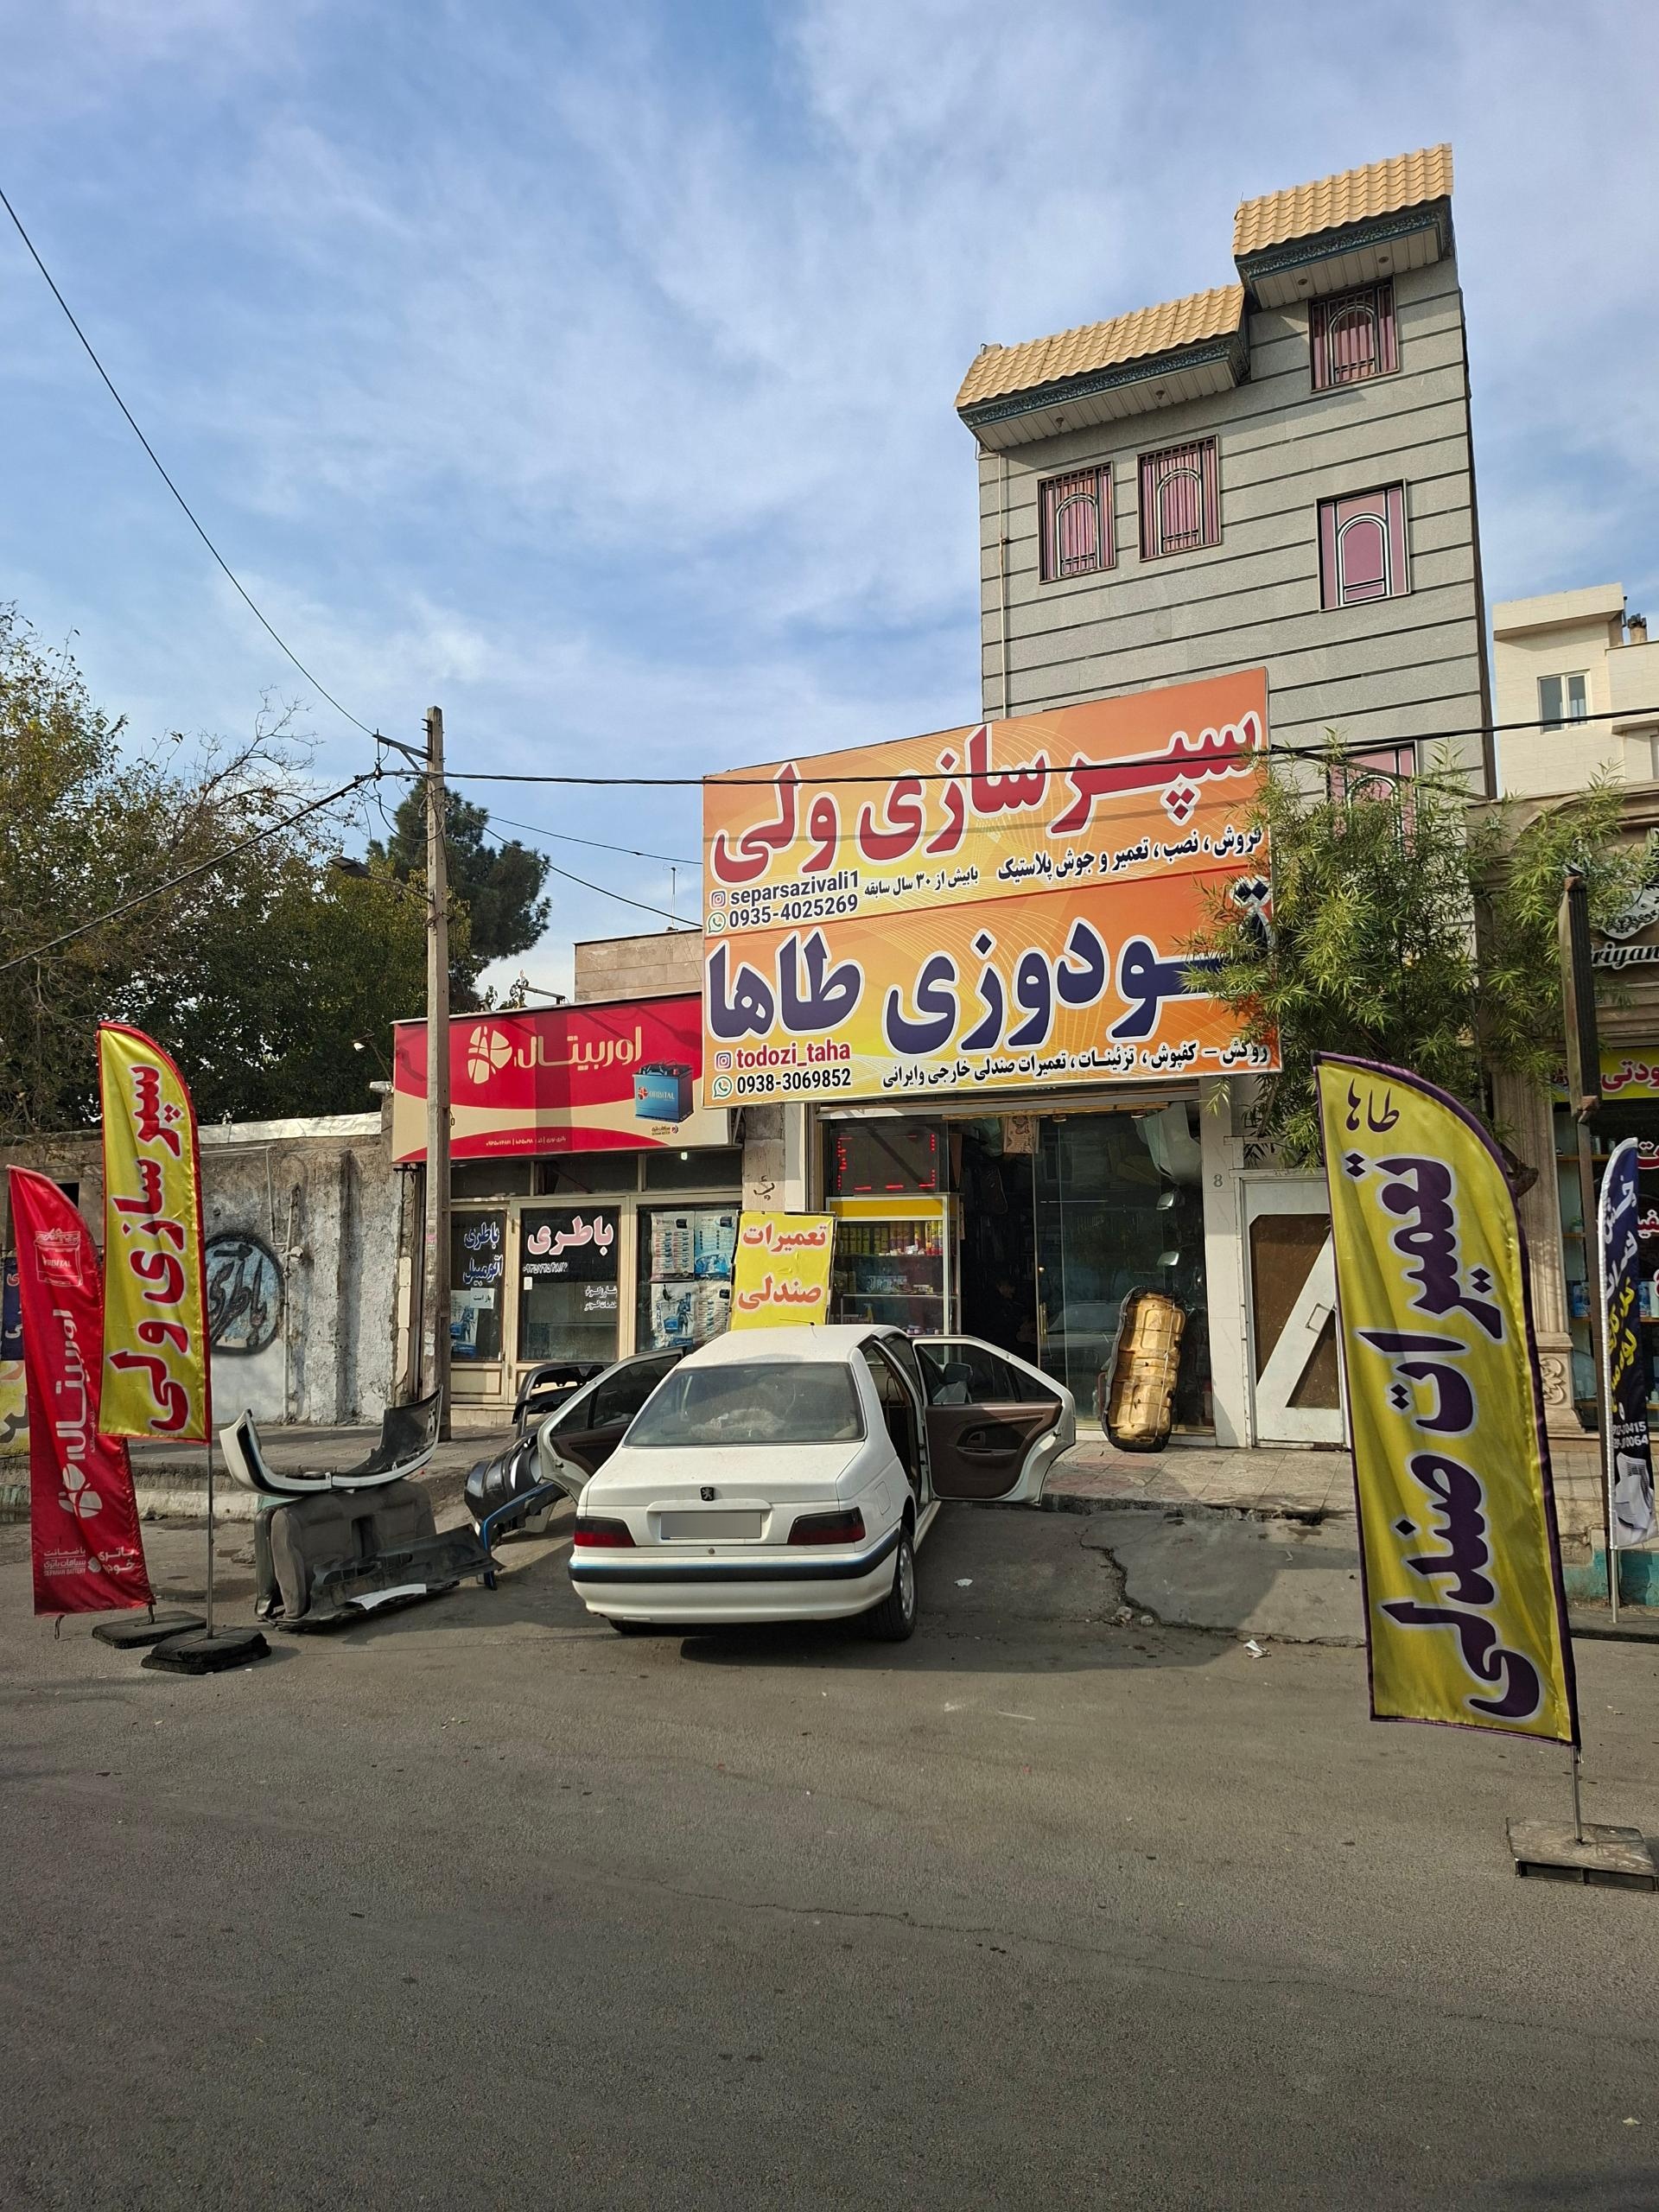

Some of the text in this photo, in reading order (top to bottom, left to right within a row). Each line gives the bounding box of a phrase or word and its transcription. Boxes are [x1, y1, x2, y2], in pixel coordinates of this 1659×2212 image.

[715, 760, 839, 883] ولی
[998, 852, 1052, 883] پلاستیک
[1056, 850, 1095, 878] جوش
[1098, 854, 1108, 873] و
[1113, 839, 1148, 871] تعمیر
[730, 870, 858, 906] separsazivali1
[864, 880, 890, 899] سابقه
[893, 877, 913, 896] سال
[916, 872, 931, 887] ۳۰
[935, 871, 945, 891] از
[729, 893, 858, 928] 0935-4025269
[709, 934, 861, 1039] طاها
[513, 1026, 642, 1071] اوربیتال
[737, 1039, 851, 1069] todozi_taha
[1222, 1039, 1268, 1065] روکش
[928, 1059, 971, 1084] خارجی
[974, 1058, 1014, 1081] صندلی
[1019, 1052, 1066, 1077] تعمیرات
[649, 1090, 676, 1100] ORBITAL
[737, 1067, 852, 1094] 0938-3069852
[1345, 1077, 1400, 1133] طاها
[1213, 1174, 1224, 1187] 8
[463, 1221, 500, 1250] باطری
[526, 1214, 614, 1257] باطری
[742, 1223, 828, 1254] تعمیرات
[738, 1275, 823, 1311] صندلی
[53, 1308, 91, 1461] اوربیتال
[109, 1319, 188, 1433] ولی
[1342, 1153, 1543, 1719] تعمیرات صندلی
